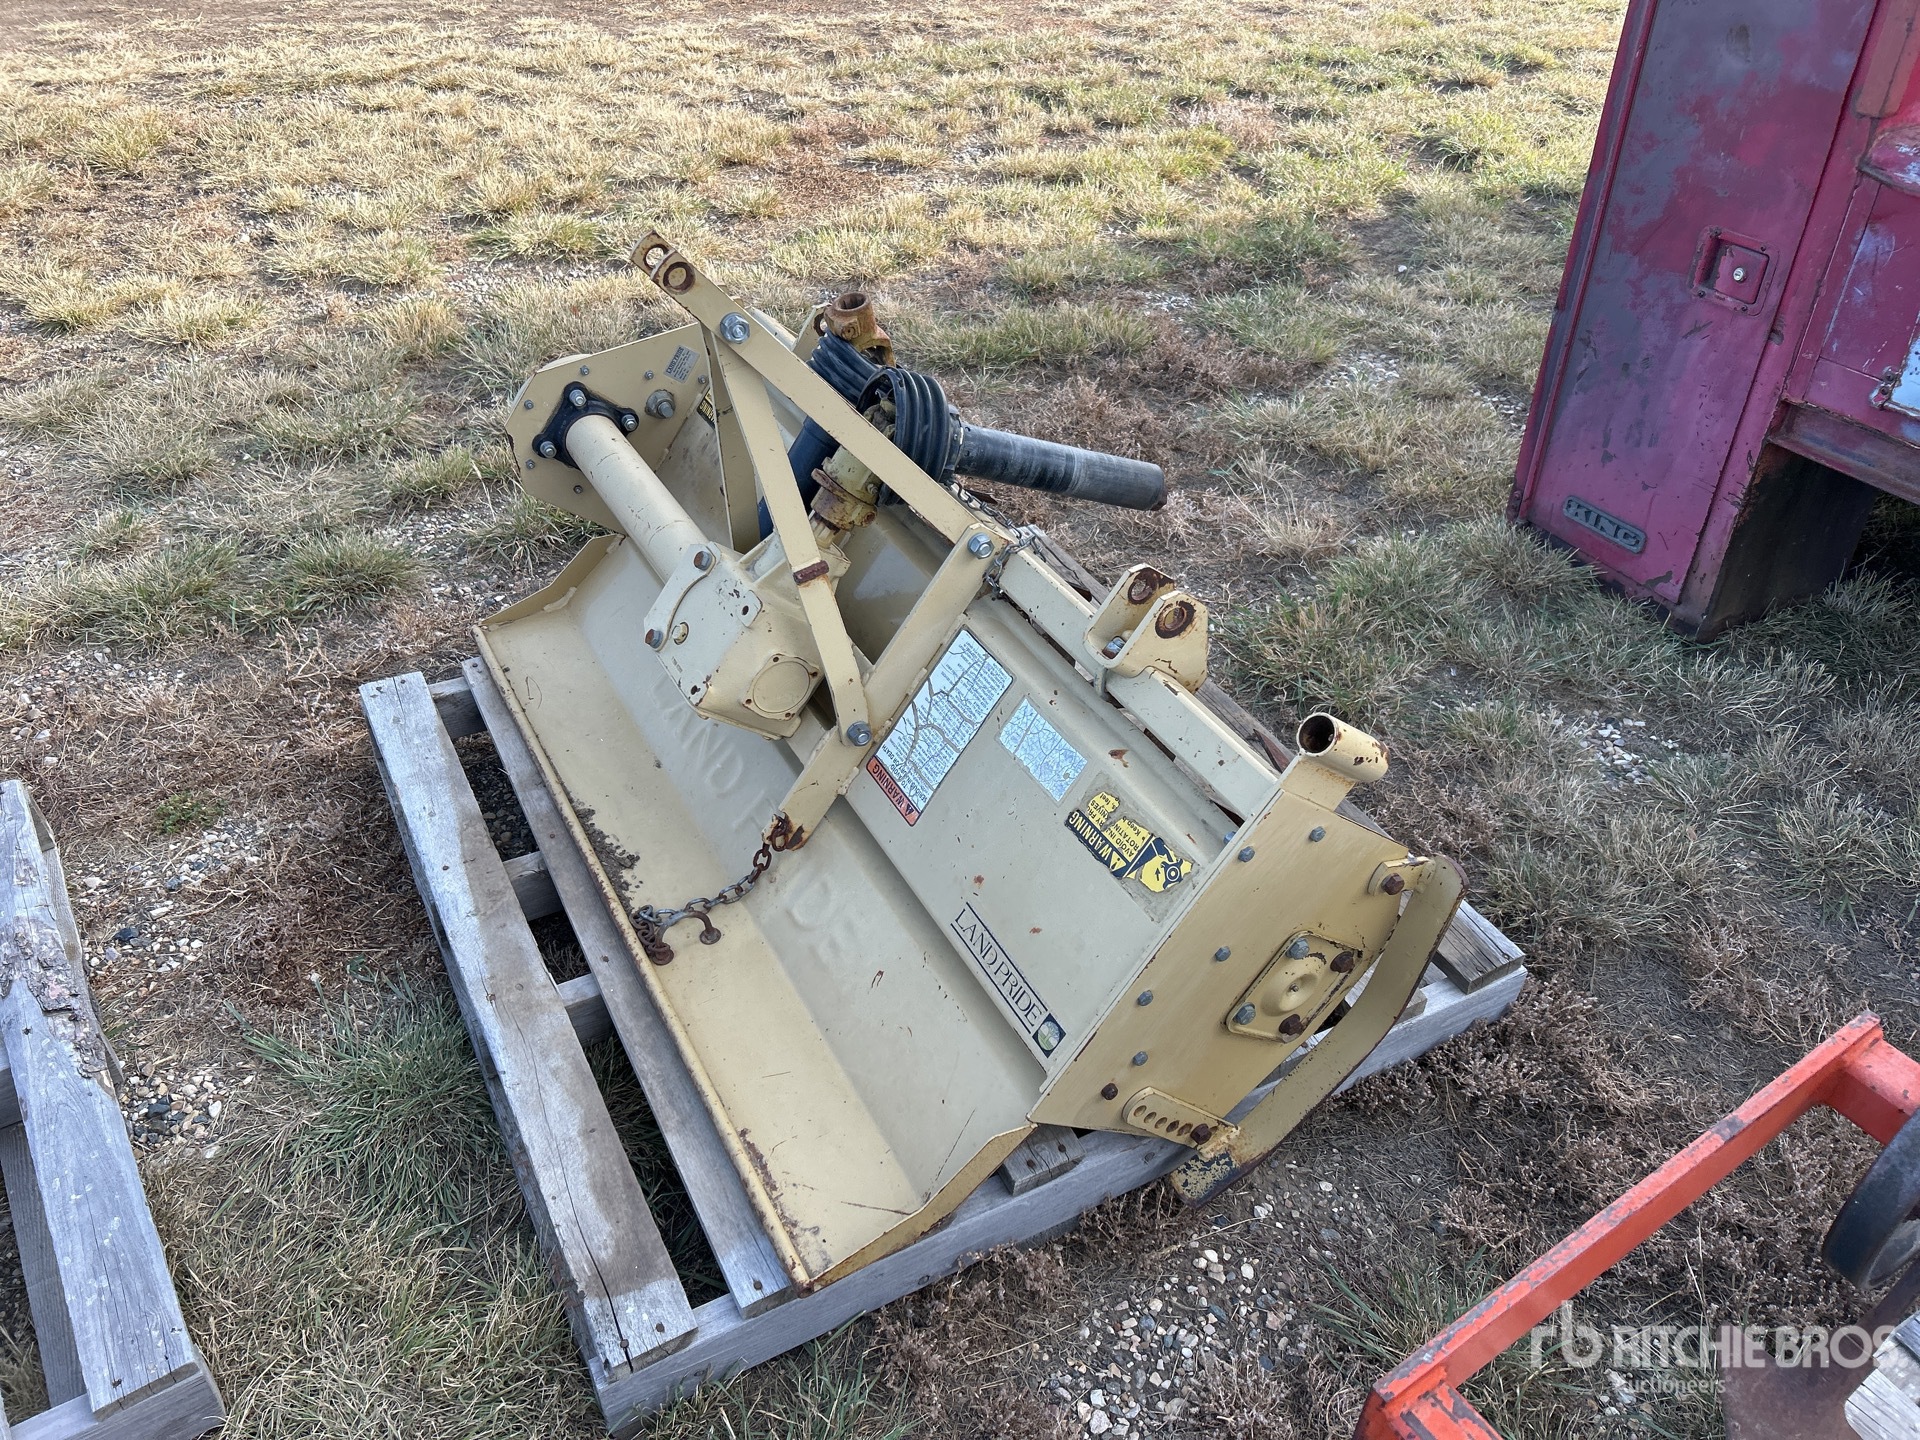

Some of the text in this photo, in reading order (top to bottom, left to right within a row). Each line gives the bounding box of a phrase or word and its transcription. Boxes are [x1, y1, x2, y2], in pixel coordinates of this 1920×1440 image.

[1566, 500, 1640, 546] KING
[881, 743, 894, 759] DEATH
[871, 763, 905, 807] WARNING
[900, 780, 906, 788] TO
[1067, 810, 1112, 860] WARNING
[1114, 837, 1134, 857] AVOID
[955, 908, 1043, 1027] LAND PRIDE
